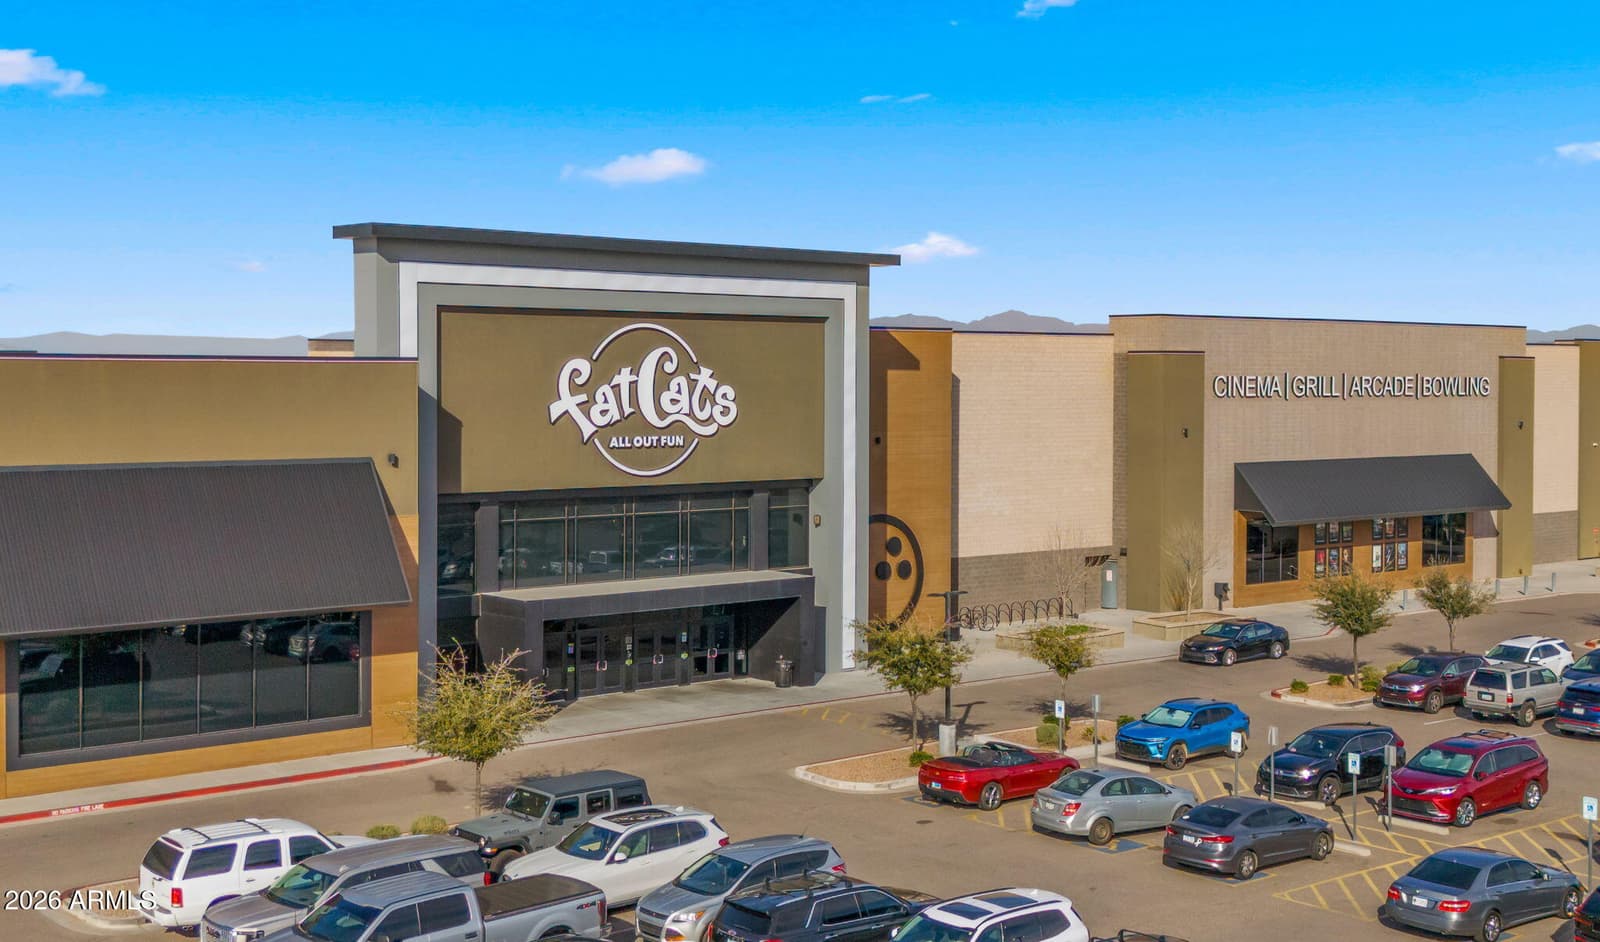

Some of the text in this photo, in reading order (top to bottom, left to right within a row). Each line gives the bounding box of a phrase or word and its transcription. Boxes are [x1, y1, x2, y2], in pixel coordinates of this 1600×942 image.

[1214, 375, 1490, 398] CINEMA GRILL ARCADE BOWLING
[609, 435, 684, 449] ALL OUT FUN
